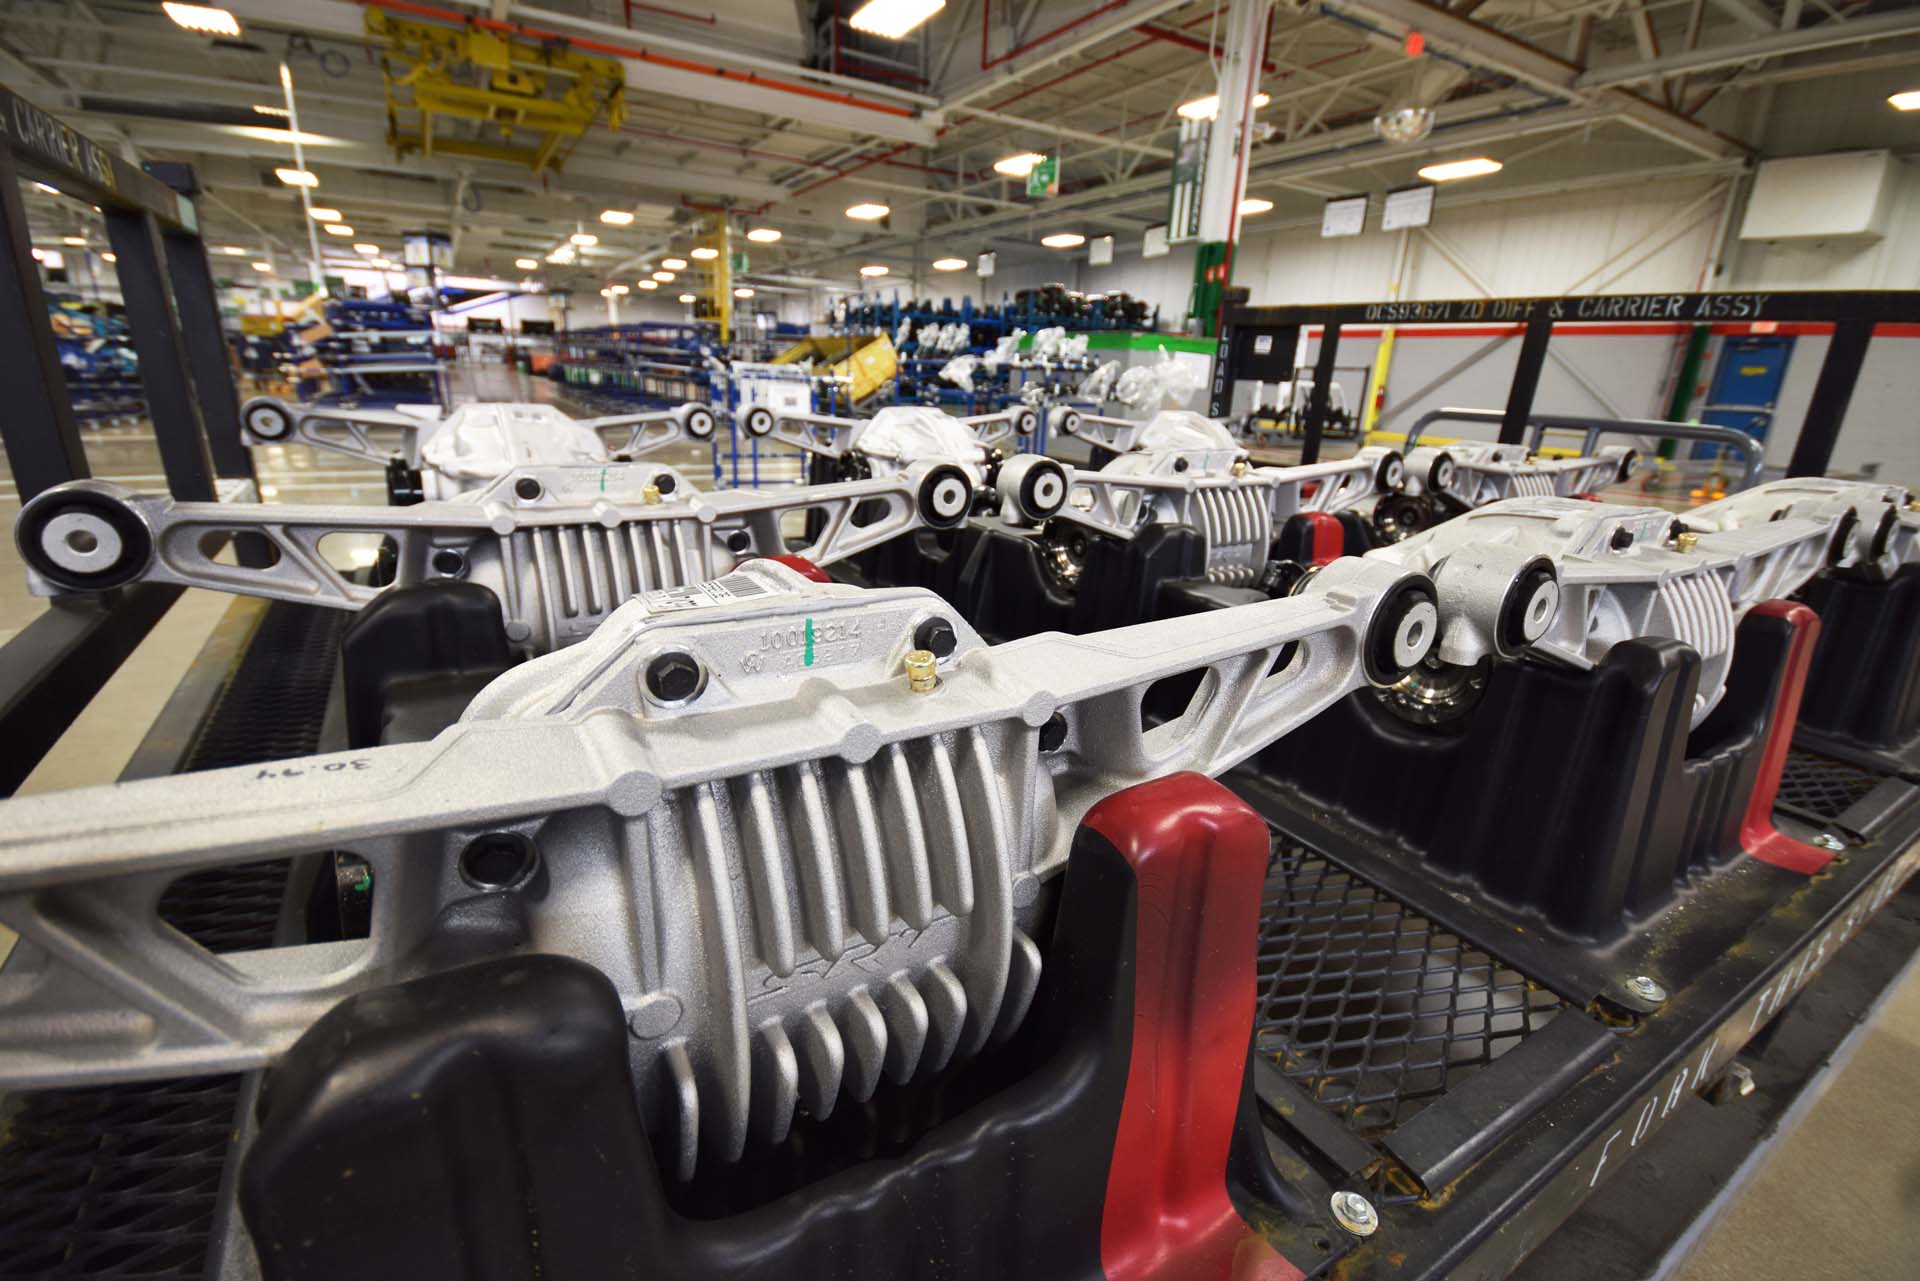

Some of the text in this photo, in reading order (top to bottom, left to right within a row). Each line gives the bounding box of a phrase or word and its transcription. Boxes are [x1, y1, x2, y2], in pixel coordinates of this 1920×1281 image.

[1577, 295, 1685, 318] CARRIER
[1695, 294, 1769, 318] ASSY
[1590, 1037, 1720, 1188] FORK
